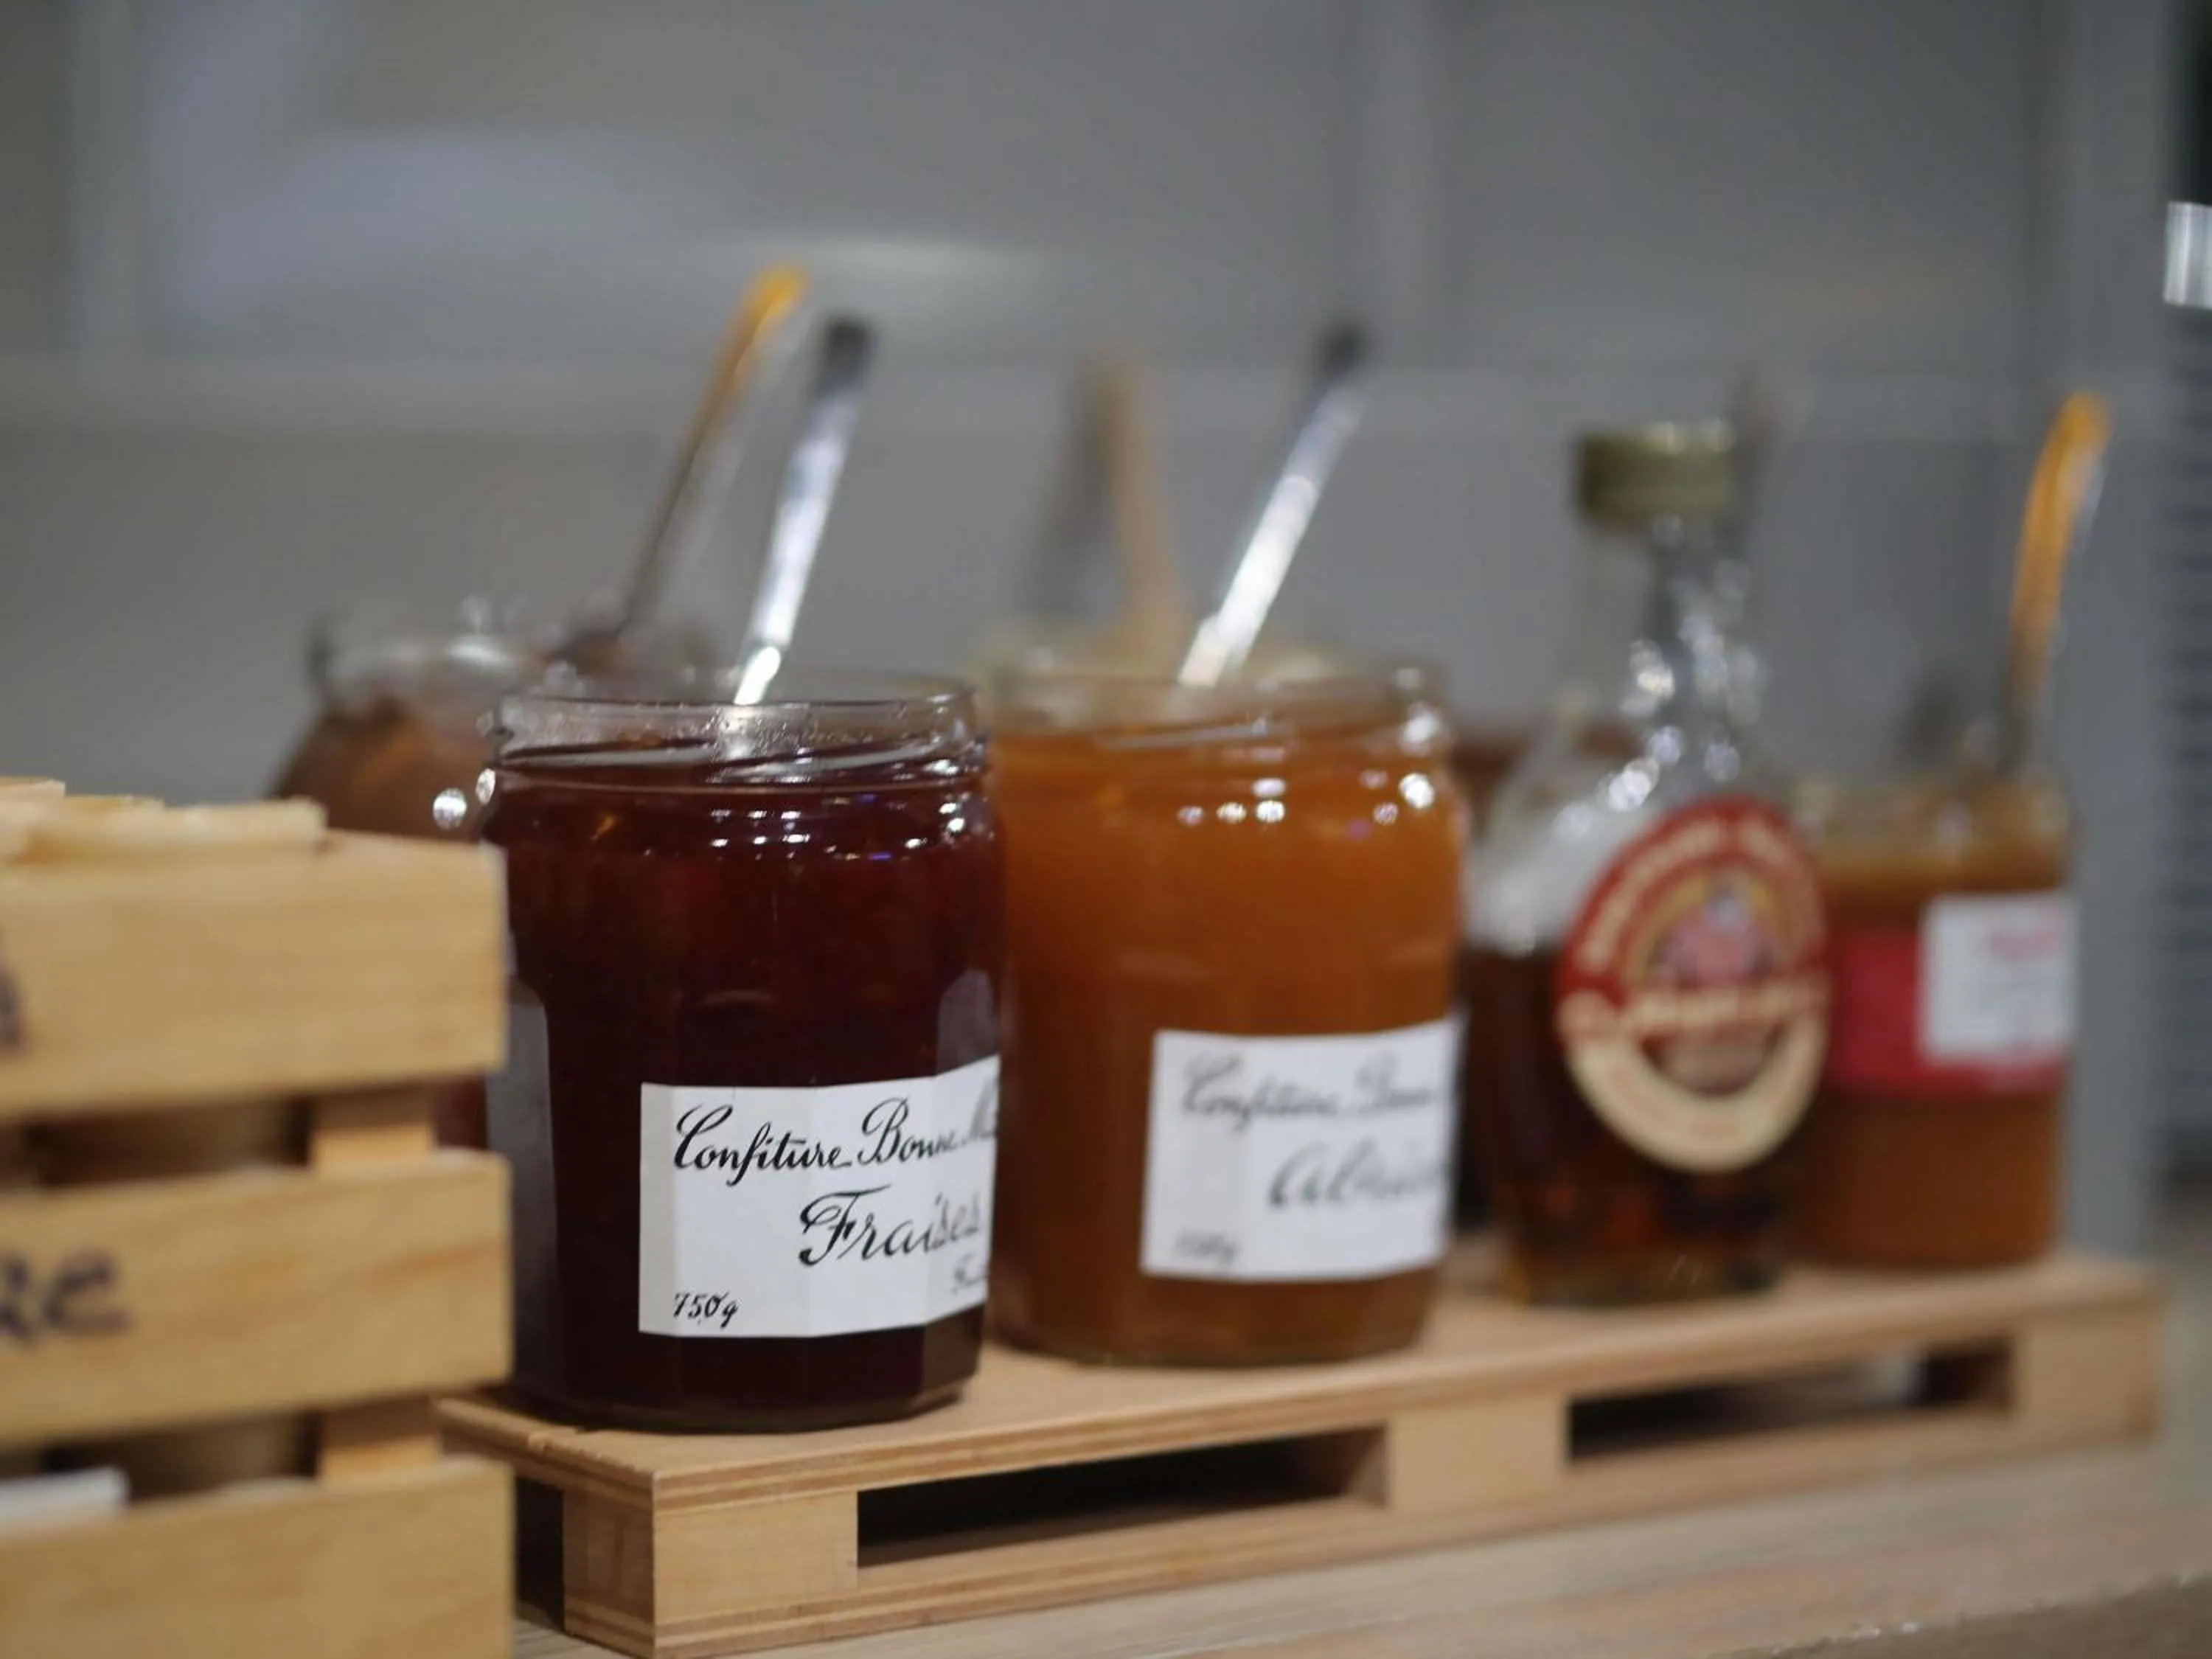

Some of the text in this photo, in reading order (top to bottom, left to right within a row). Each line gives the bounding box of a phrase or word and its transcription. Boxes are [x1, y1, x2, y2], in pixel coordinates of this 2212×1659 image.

[674, 1105, 851, 1186] Confiture
[858, 1096, 959, 1166] Bonne
[799, 1184, 979, 1267] Fraises
[672, 1291, 739, 1330] 750g
